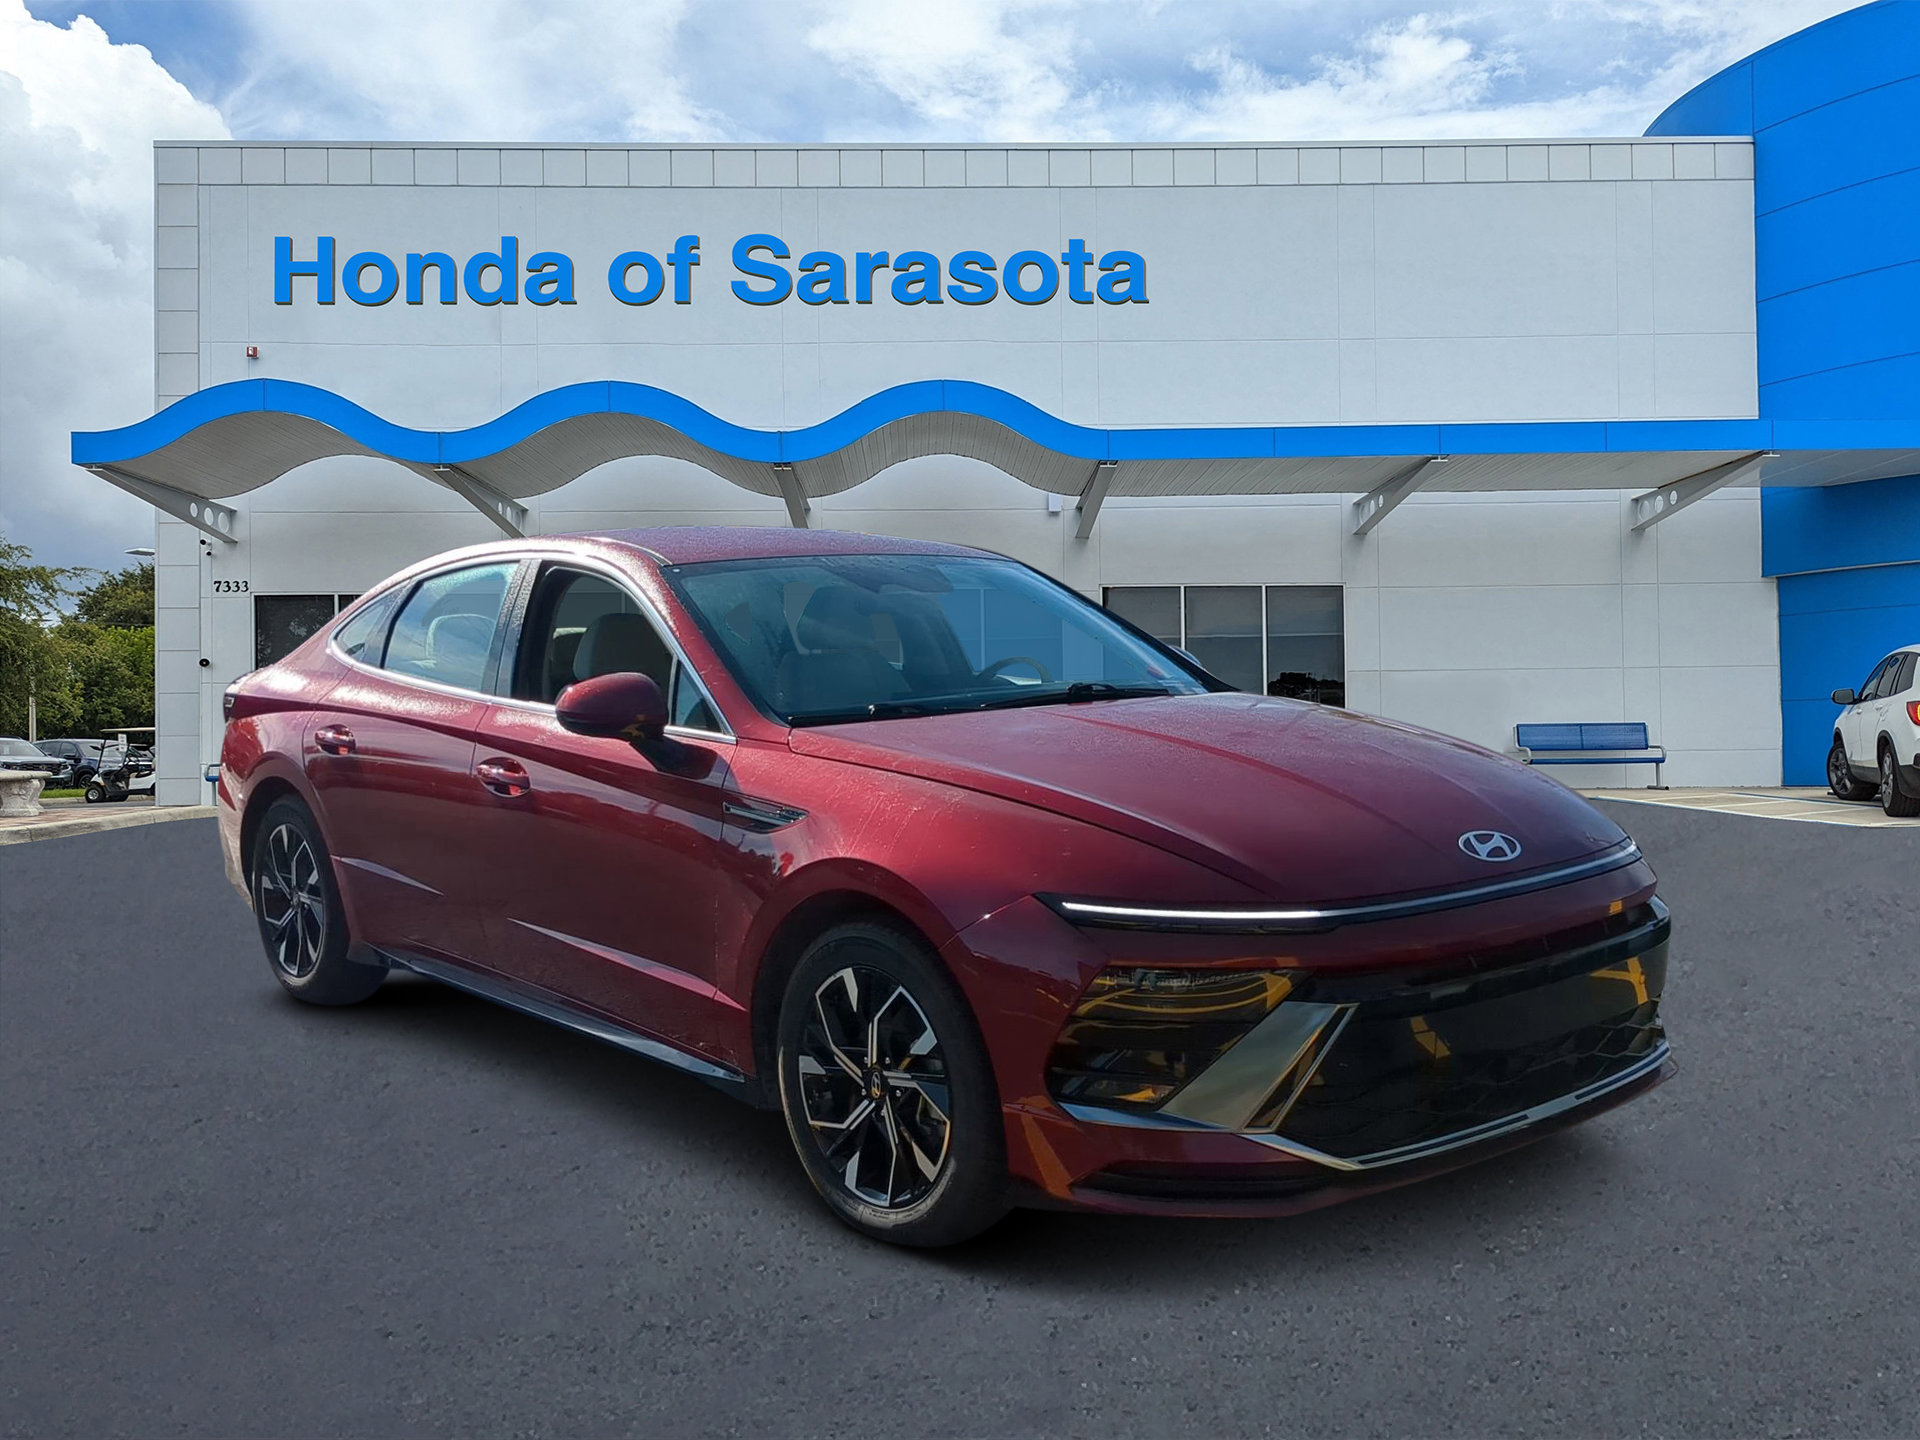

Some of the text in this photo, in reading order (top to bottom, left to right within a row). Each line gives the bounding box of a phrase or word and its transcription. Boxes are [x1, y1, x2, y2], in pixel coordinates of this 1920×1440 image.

[273, 233, 1150, 306] Honda of Sarasota
[213, 580, 249, 593] 7333
